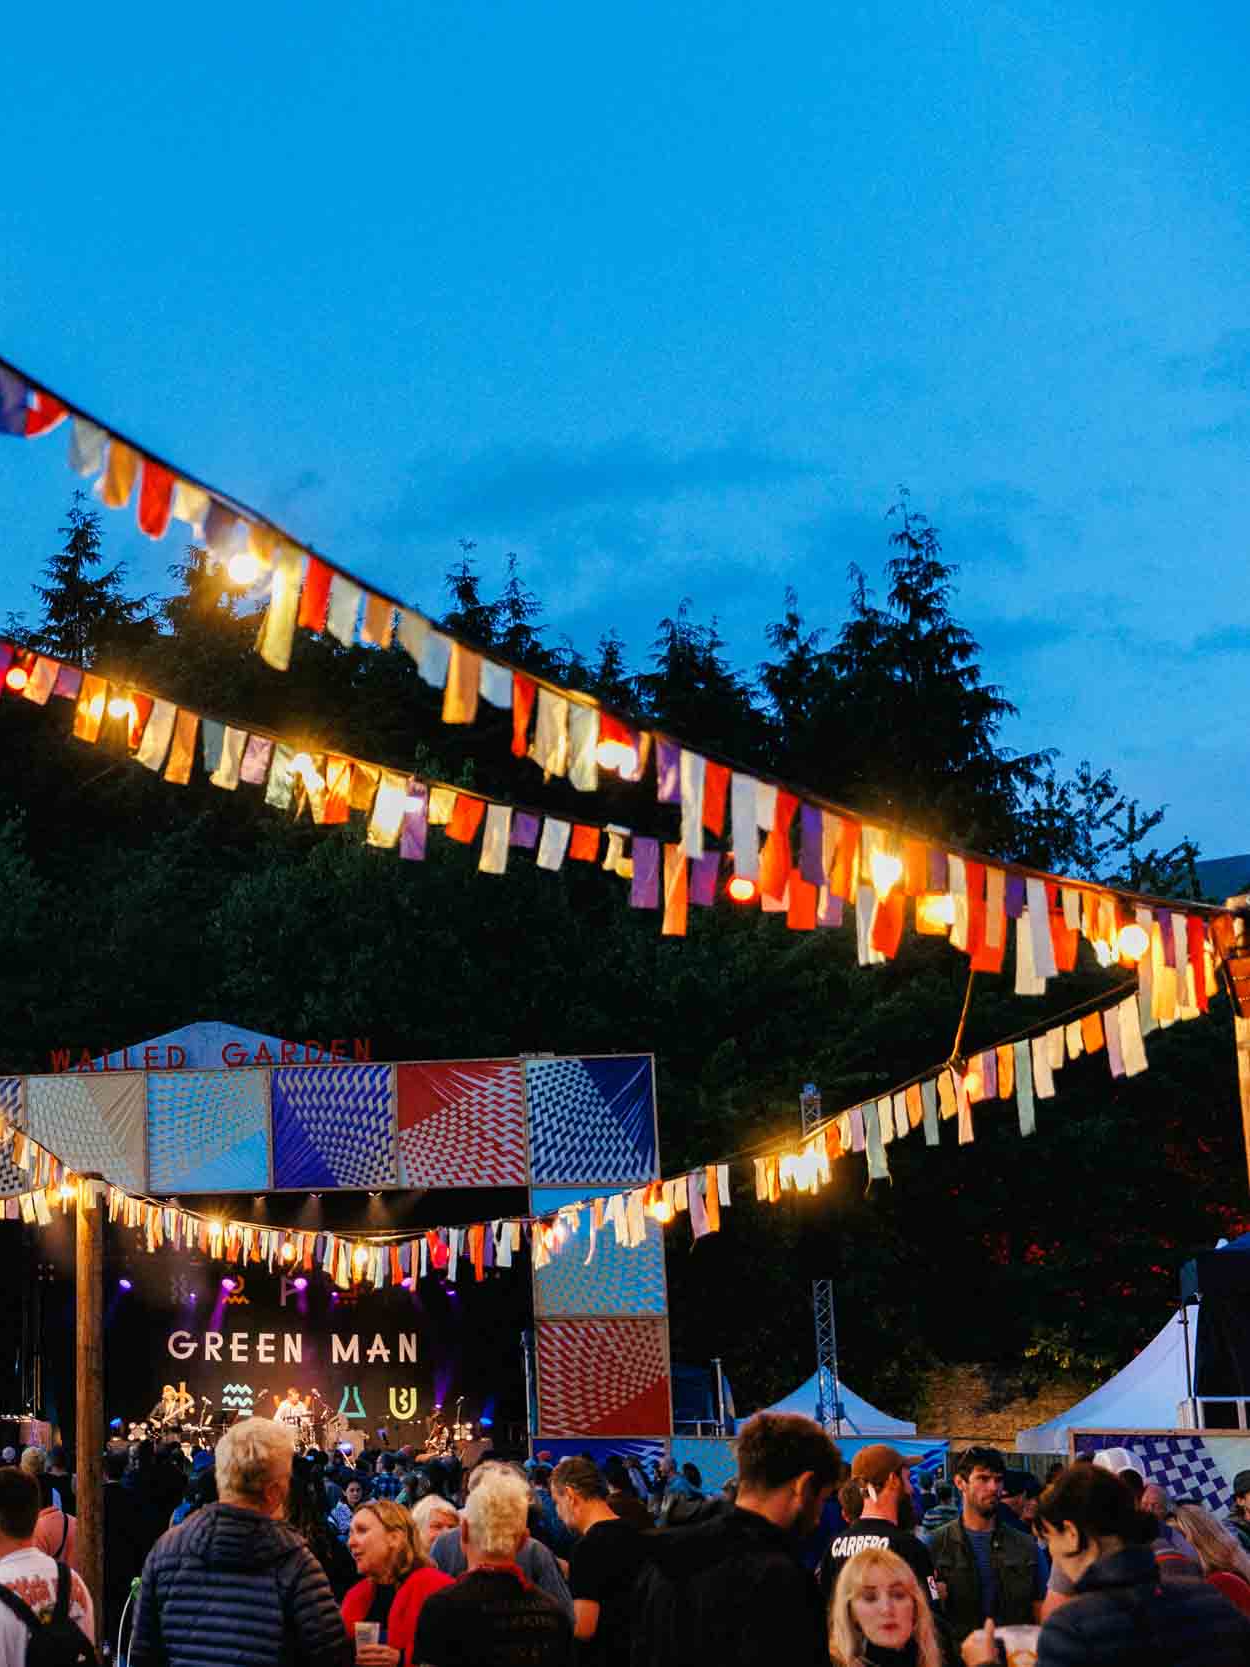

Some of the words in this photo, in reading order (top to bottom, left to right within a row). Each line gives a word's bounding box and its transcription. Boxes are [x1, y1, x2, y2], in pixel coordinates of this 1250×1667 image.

[51, 1045, 186, 1072] WALLED
[222, 1039, 372, 1067] GARDEN
[167, 1330, 302, 1363] GREEN
[331, 1333, 417, 1364] MAN
